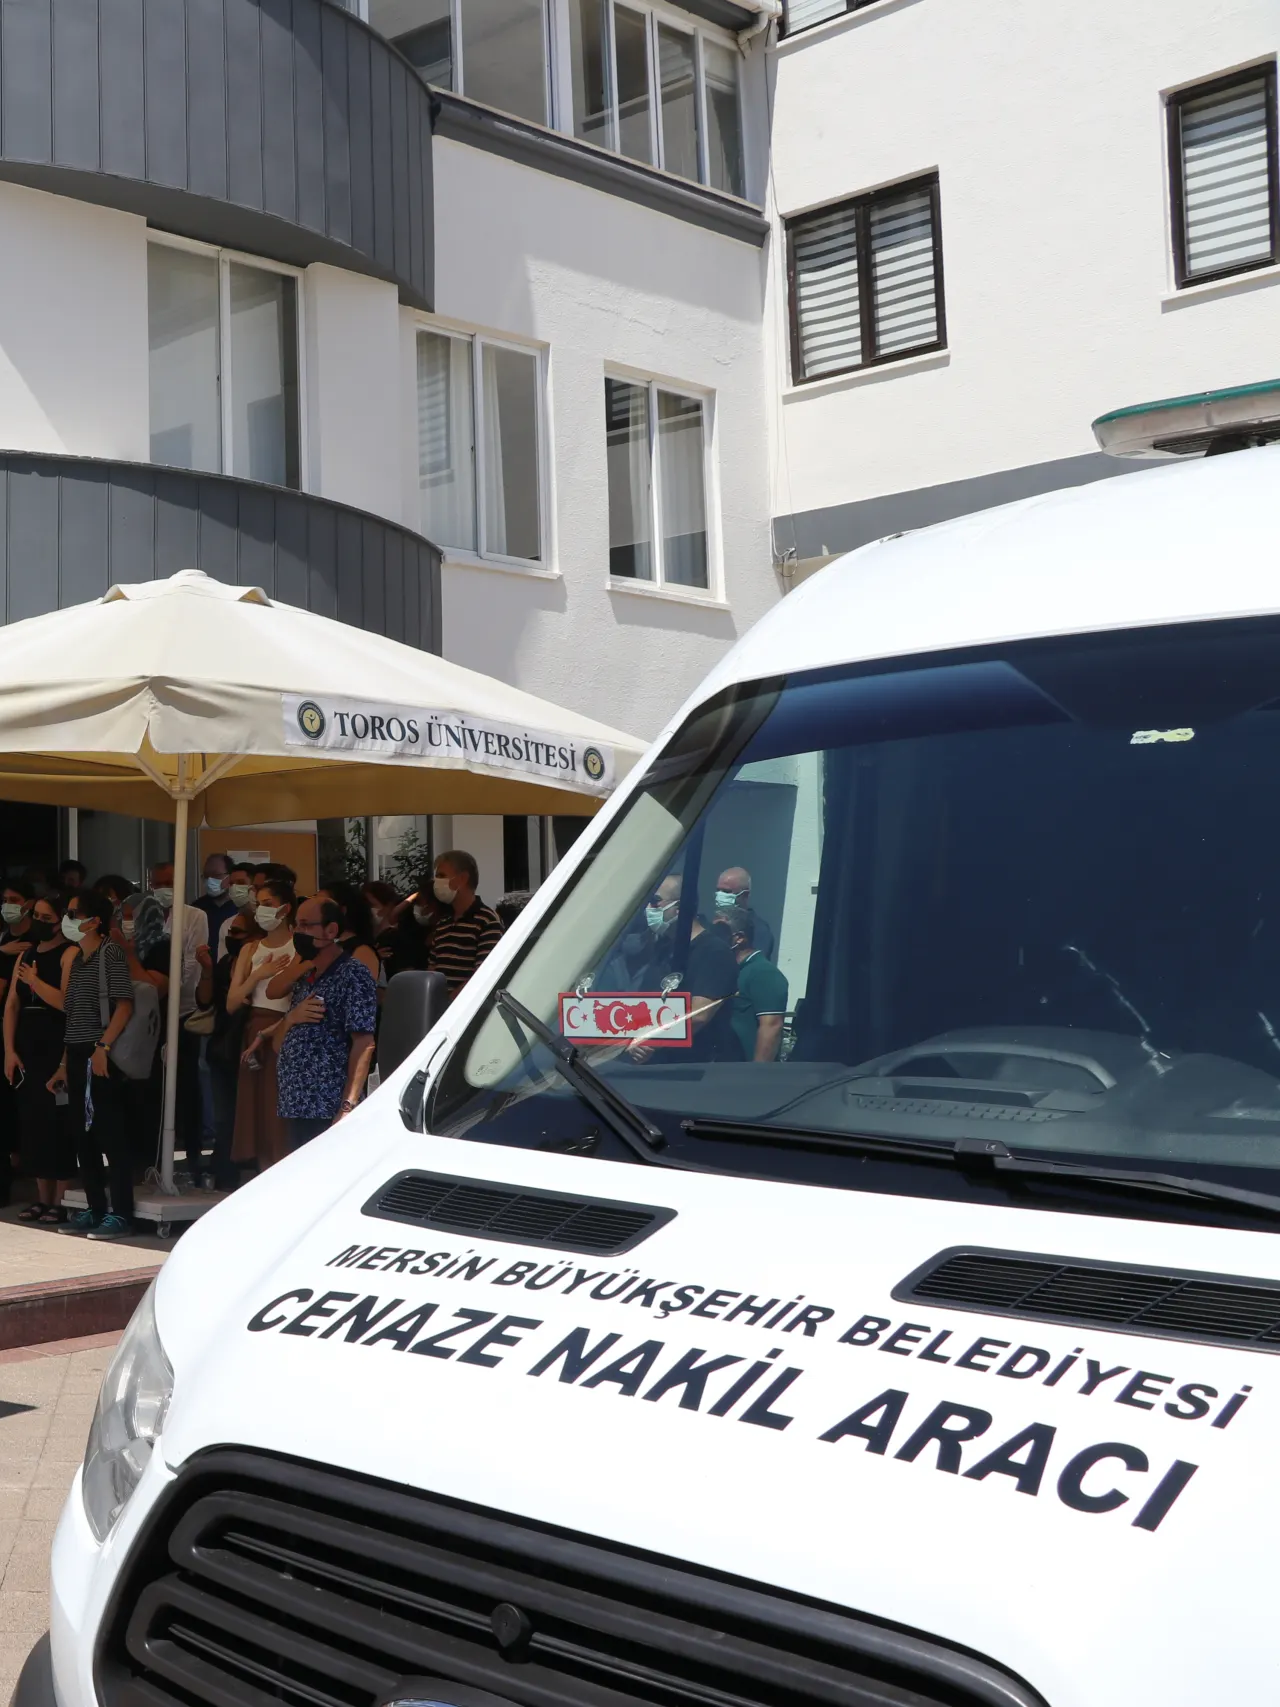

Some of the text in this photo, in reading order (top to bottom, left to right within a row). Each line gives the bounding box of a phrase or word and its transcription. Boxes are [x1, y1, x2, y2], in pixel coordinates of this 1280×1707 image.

[334, 711, 577, 772] TOROS ÜNİVERSİTESİ
[247, 1287, 1200, 1533] CENAZE NAKİL ARACI
[325, 1244, 1254, 1430] MERSİN BÜYÜKŞEHİR BELEDİYESİ
